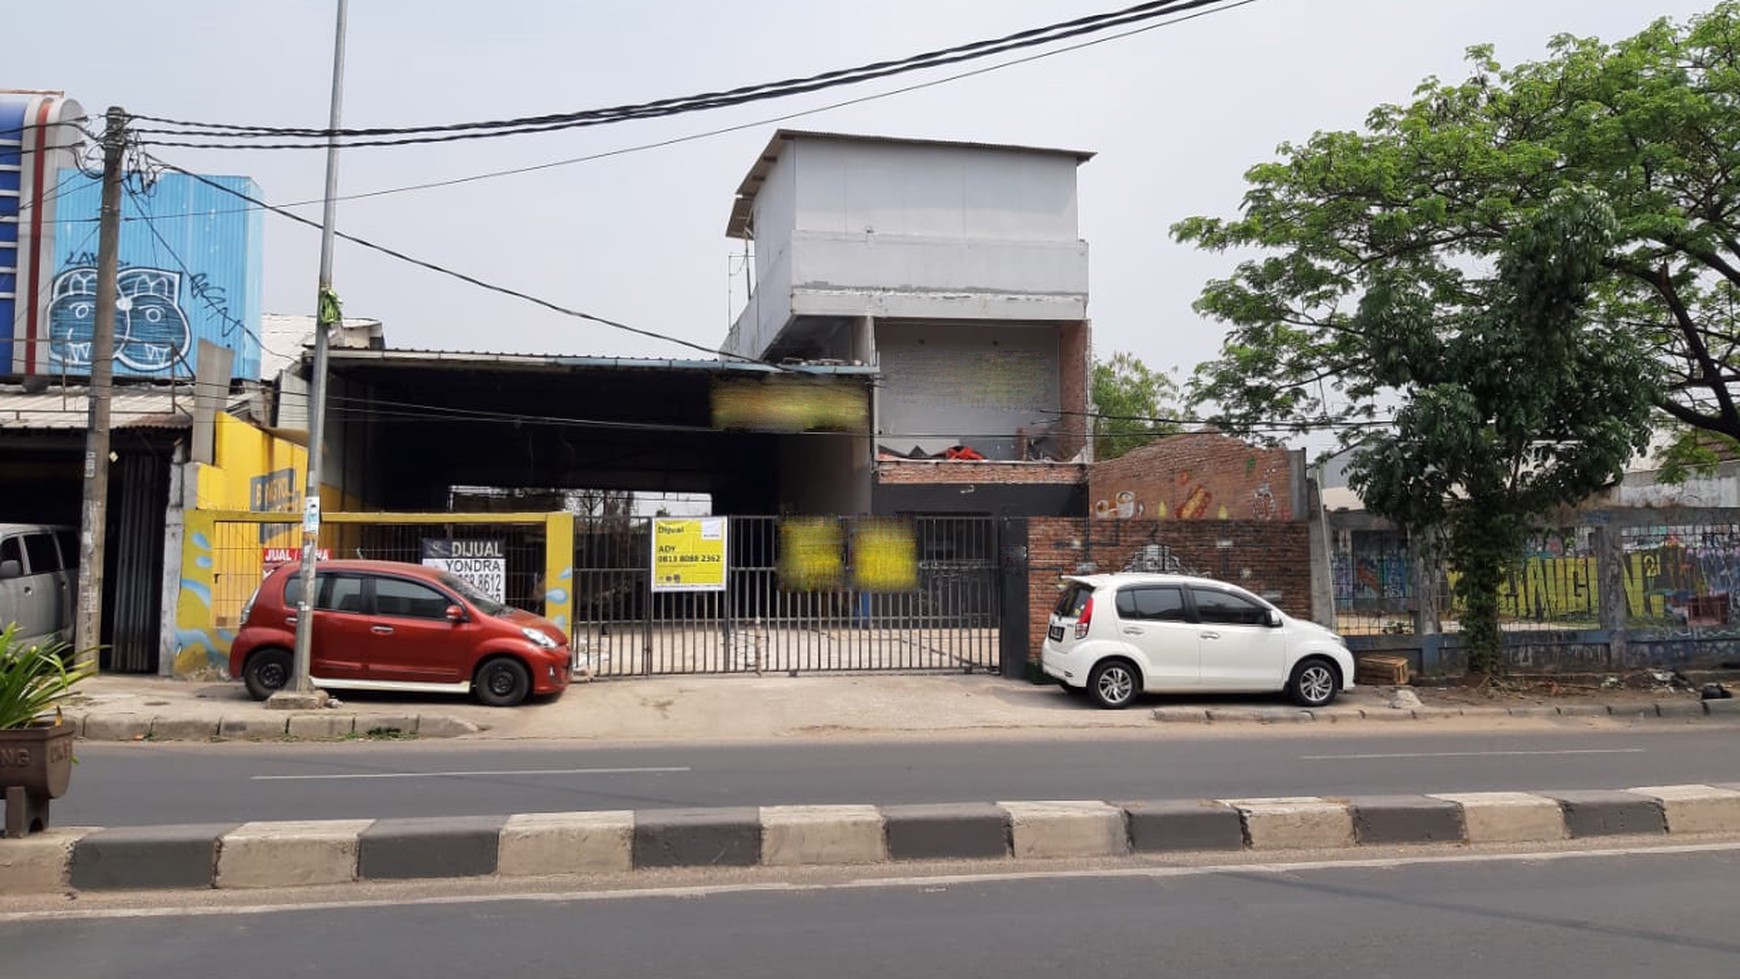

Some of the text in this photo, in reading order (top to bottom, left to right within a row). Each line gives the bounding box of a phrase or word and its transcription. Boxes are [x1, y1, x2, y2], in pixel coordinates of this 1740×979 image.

[658, 525, 684, 534] Dijual
[265, 549, 292, 561] JUAL
[452, 541, 503, 557] DIJUAL
[446, 560, 501, 572] YONDRA
